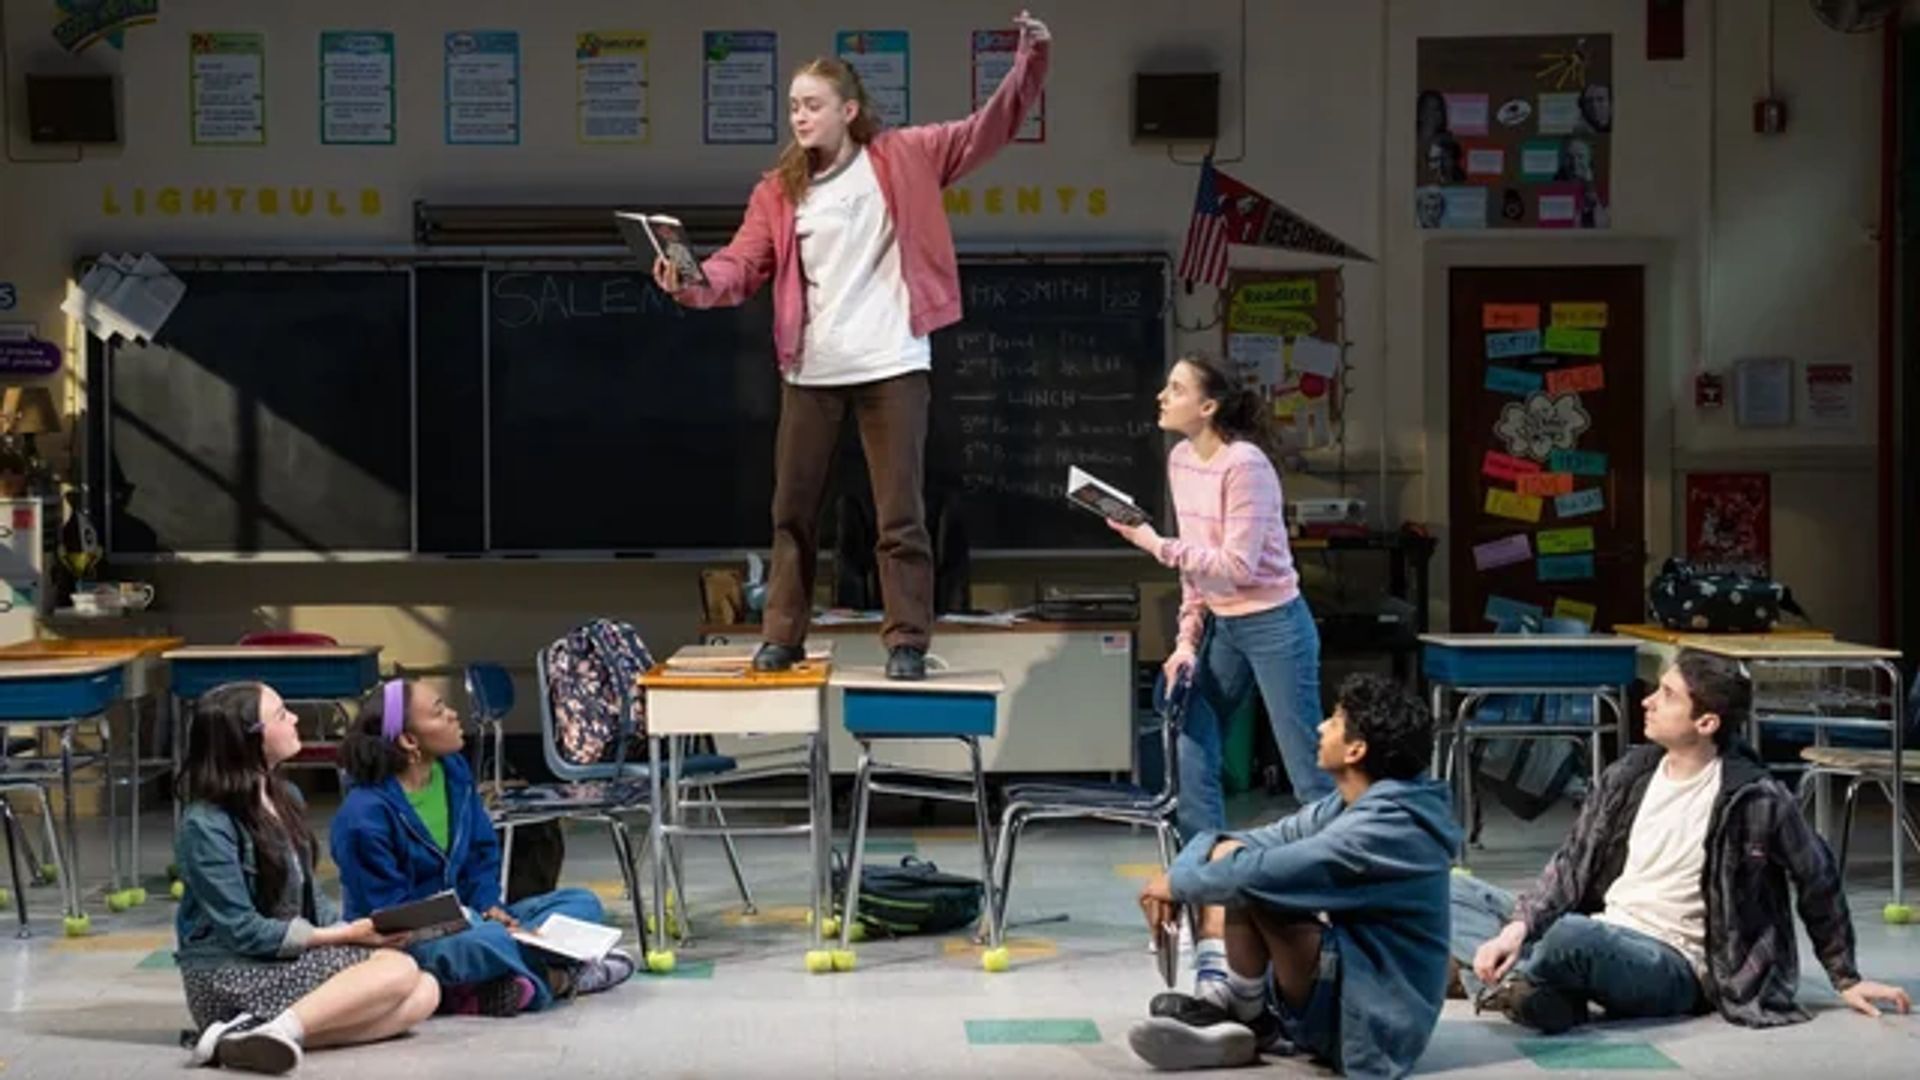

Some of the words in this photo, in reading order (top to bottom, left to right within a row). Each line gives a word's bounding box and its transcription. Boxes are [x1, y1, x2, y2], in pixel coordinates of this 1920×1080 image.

[103, 187, 383, 217] LIGHTBULB
[1264, 209, 1345, 256] GEORGIA
[1018, 279, 1089, 303] SMITH
[1244, 287, 1313, 304] Reading
[1007, 388, 1076, 410] LUNCH
